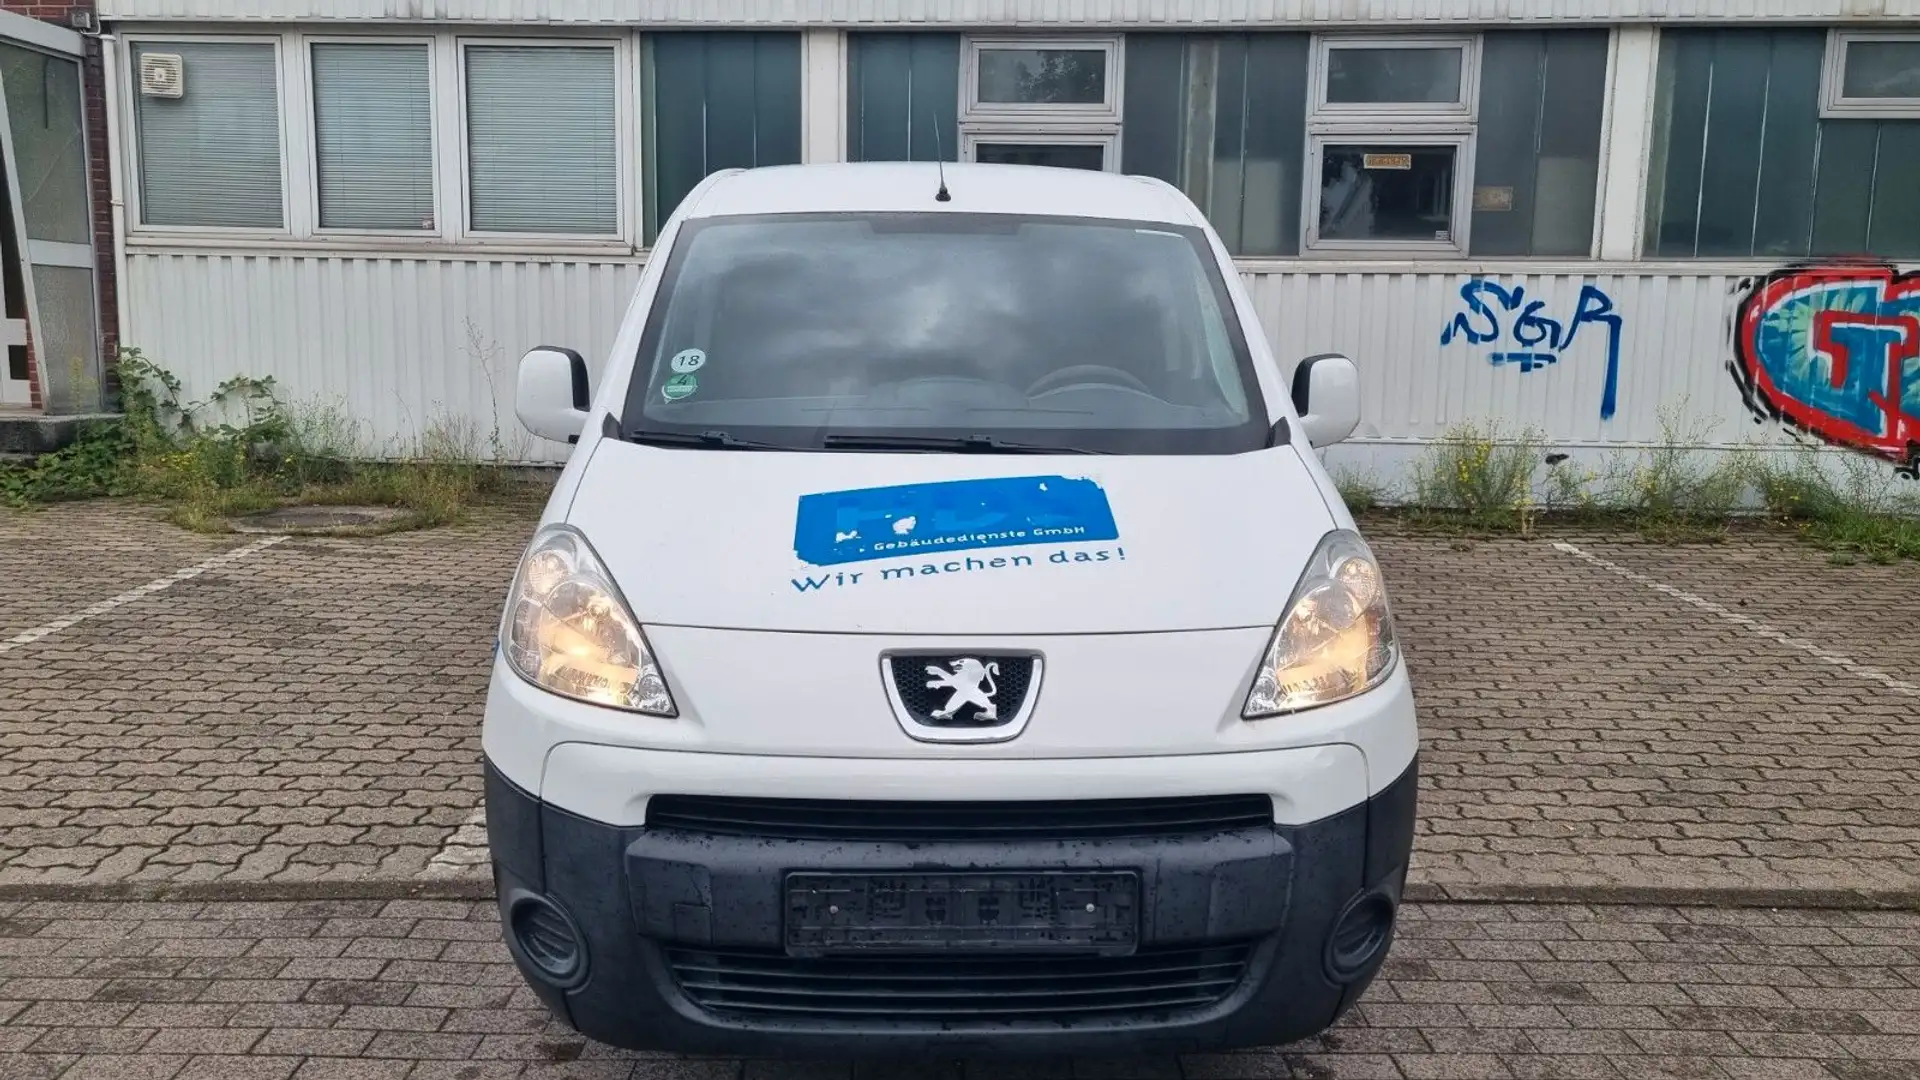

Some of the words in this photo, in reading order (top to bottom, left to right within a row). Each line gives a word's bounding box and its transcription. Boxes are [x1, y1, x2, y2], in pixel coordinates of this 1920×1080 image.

[679, 355, 700, 367] 18
[676, 374, 688, 386] 4
[873, 529, 1026, 551] Gebäudedienste
[1033, 526, 1085, 537] GmbH
[791, 572, 863, 592] Wir
[881, 555, 1032, 580] machen
[1049, 547, 1125, 564] das!
